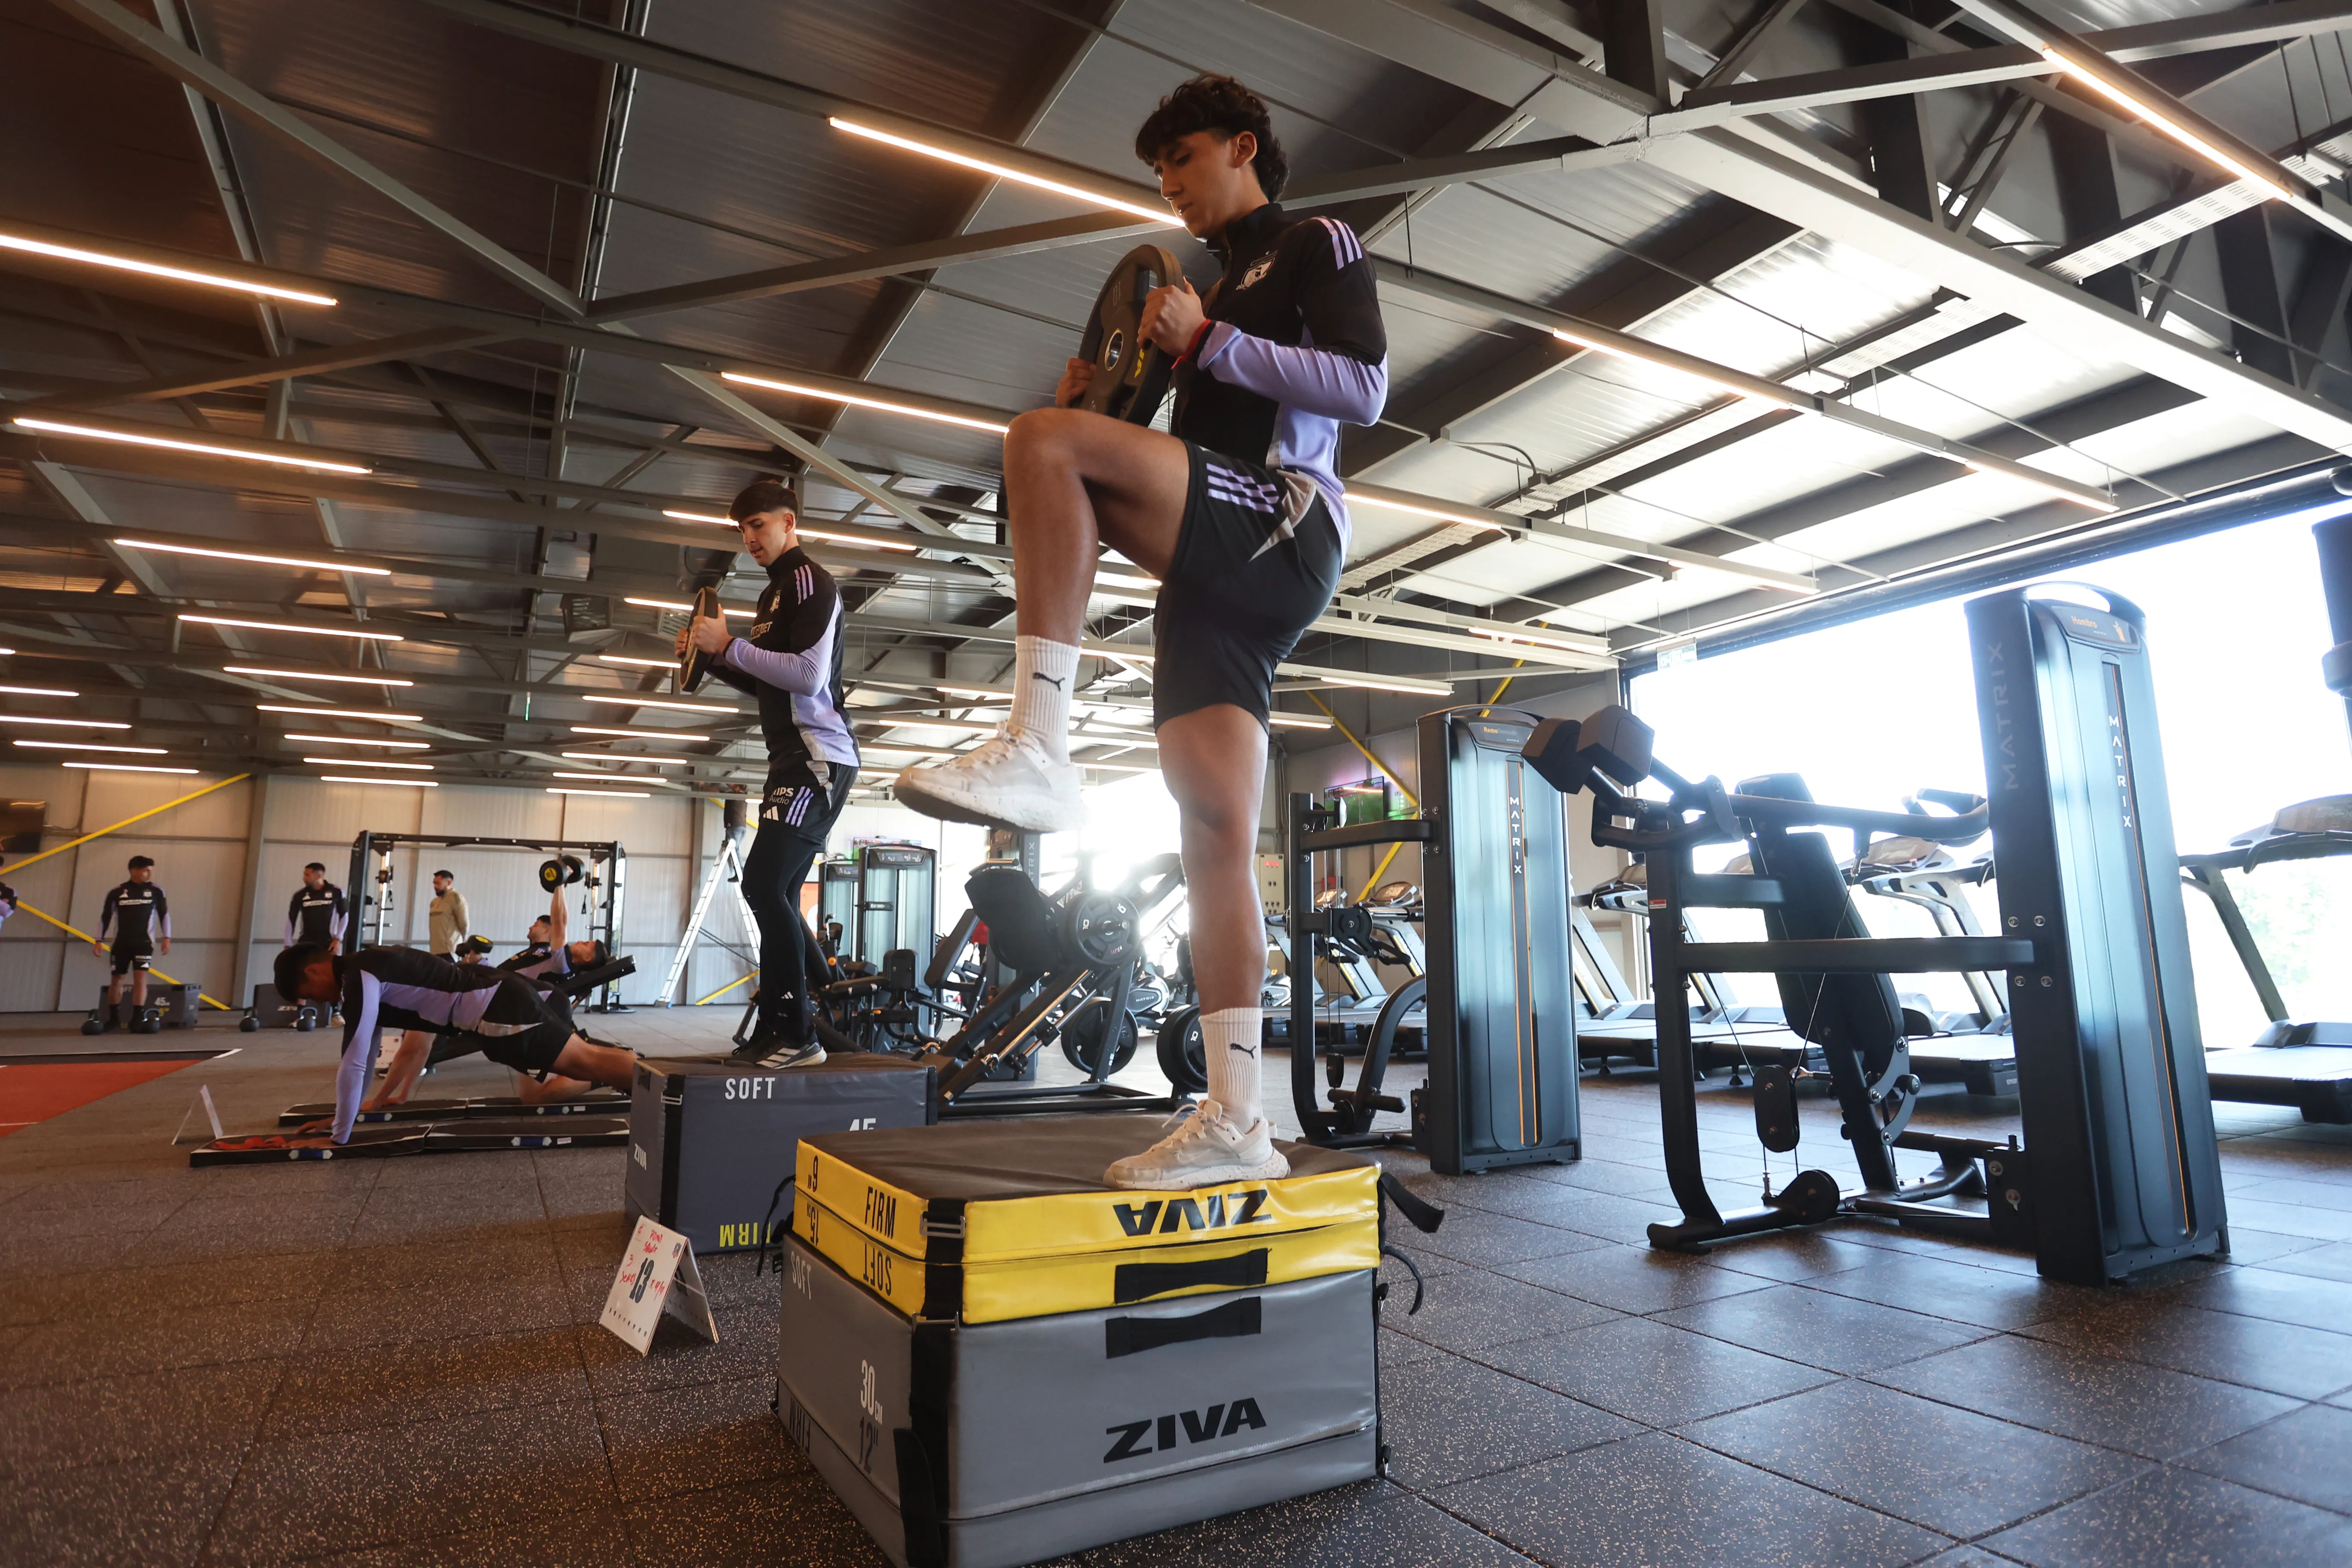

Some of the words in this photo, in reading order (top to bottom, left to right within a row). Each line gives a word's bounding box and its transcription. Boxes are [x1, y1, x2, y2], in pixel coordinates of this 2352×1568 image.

[1988, 642, 2018, 790] MATRIX
[2109, 715, 2132, 828] MATRIX
[769, 795, 789, 804] Audio
[1510, 797, 1522, 873] MATRIX
[1083, 919, 1089, 930] 10
[1117, 903, 1126, 914] 10
[1191, 1031, 1198, 1041] 10
[725, 1077, 775, 1100] SOFT
[634, 1143, 646, 1170] ZIVA
[865, 1186, 896, 1239] FIRM
[1112, 1189, 1272, 1237] ZIVA
[629, 1257, 655, 1304] 13
[791, 1251, 811, 1300] SOFT
[863, 1243, 891, 1296] SOFT
[790, 1397, 810, 1456] FIRM
[1103, 1397, 1267, 1463] ZIVA
